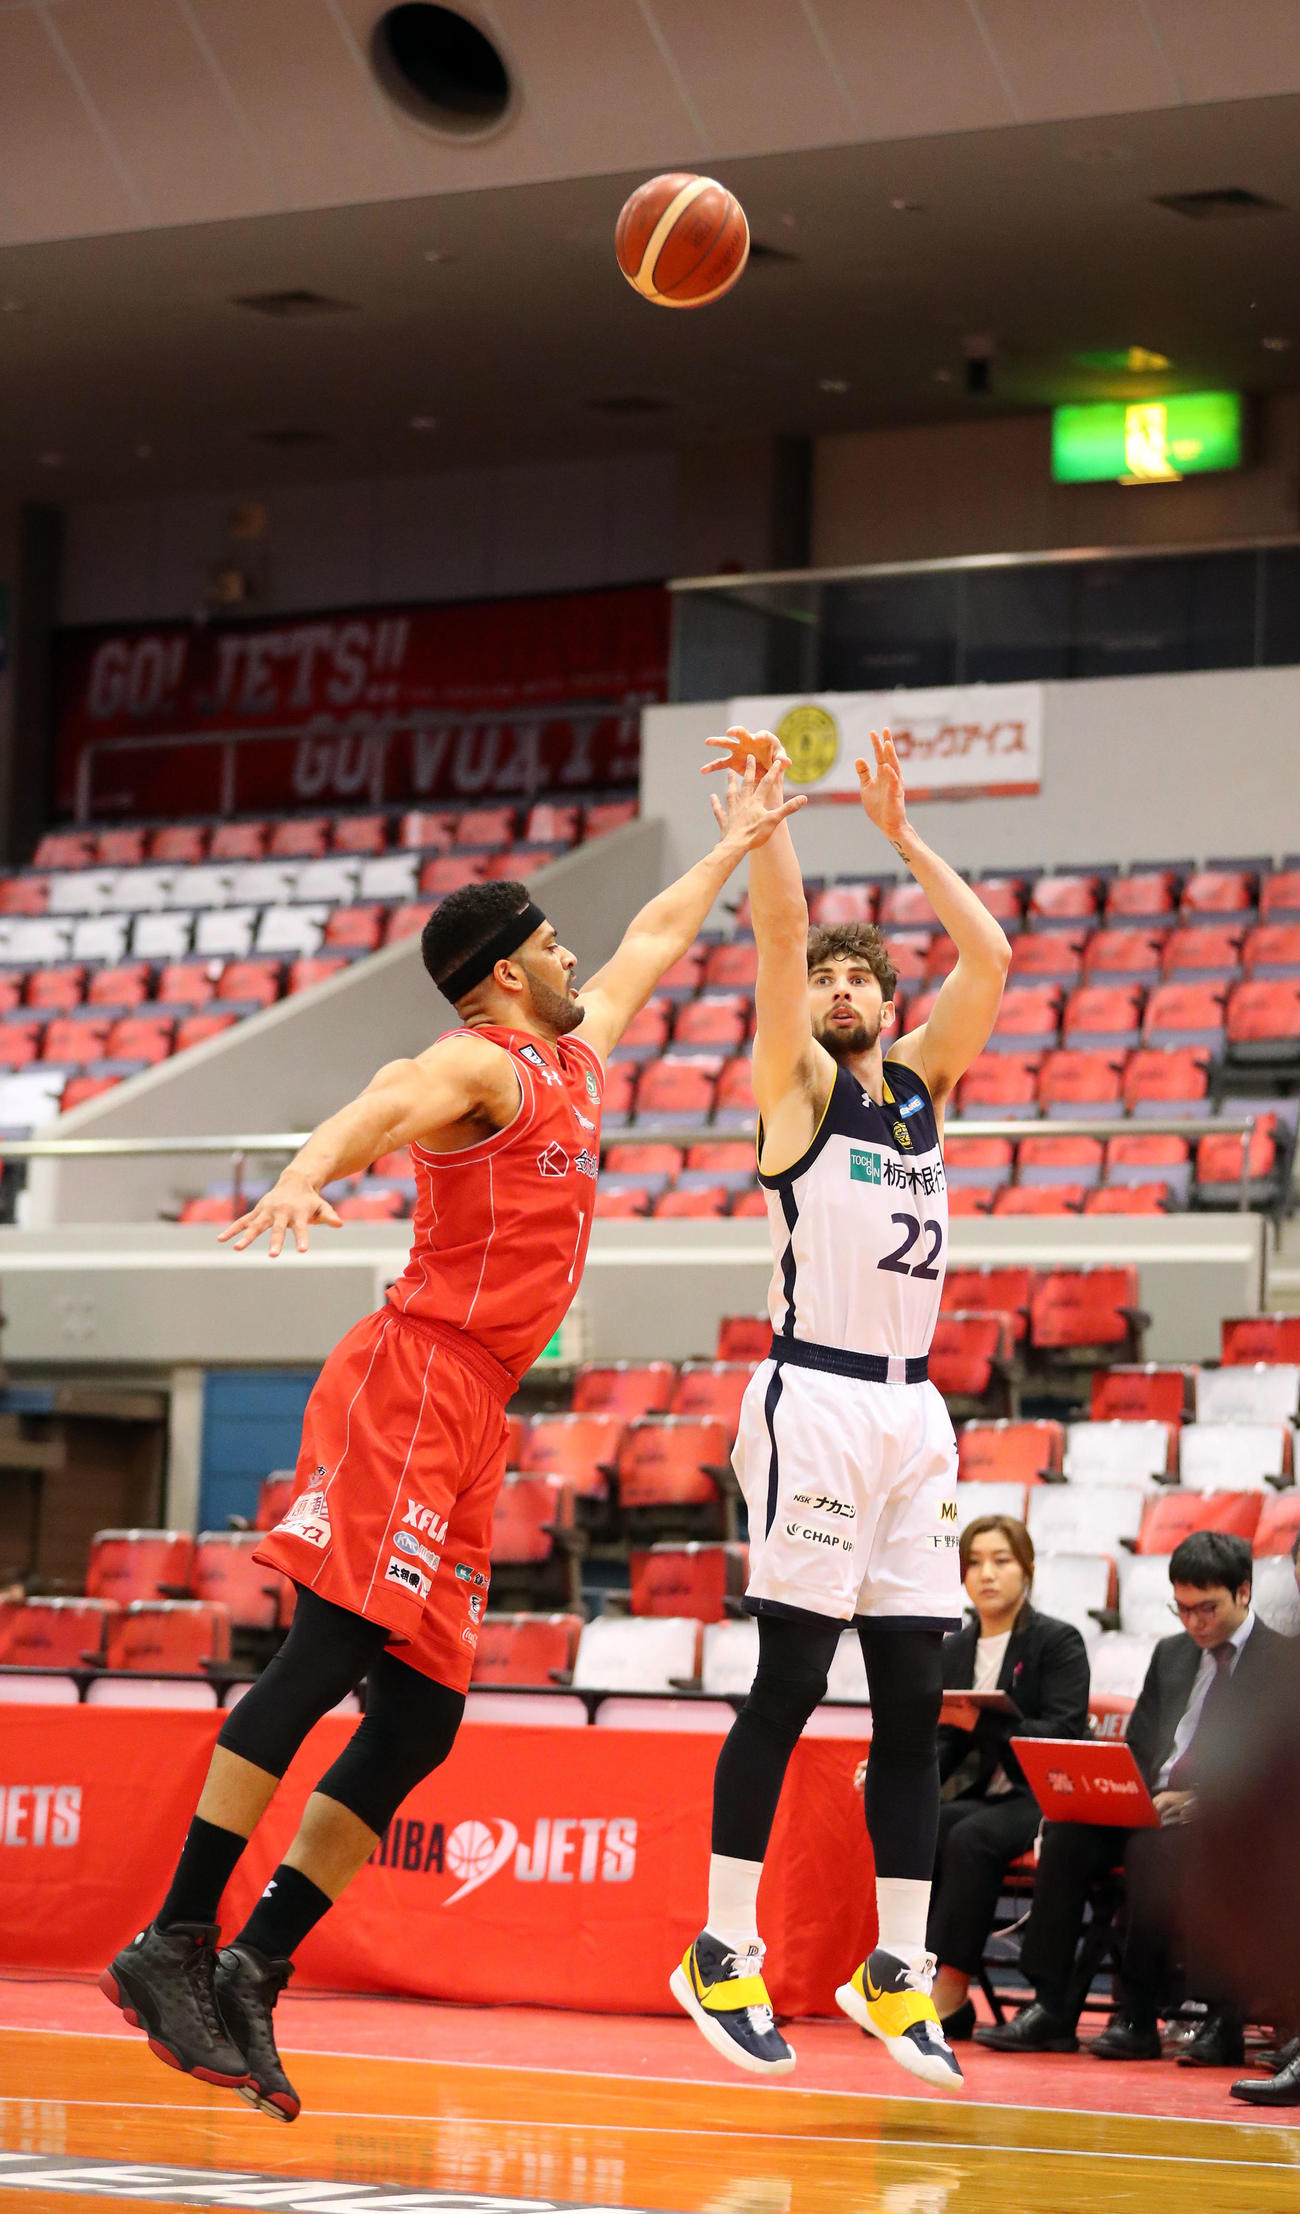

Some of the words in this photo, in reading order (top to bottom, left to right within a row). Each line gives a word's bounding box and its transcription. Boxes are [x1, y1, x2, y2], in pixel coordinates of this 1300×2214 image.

[876, 1212, 943, 1280] 22
[802, 1529, 840, 1547] CHAP
[0, 1785, 82, 1847] ETS
[368, 1818, 444, 1874] IBA
[514, 1818, 637, 1883] JETS
